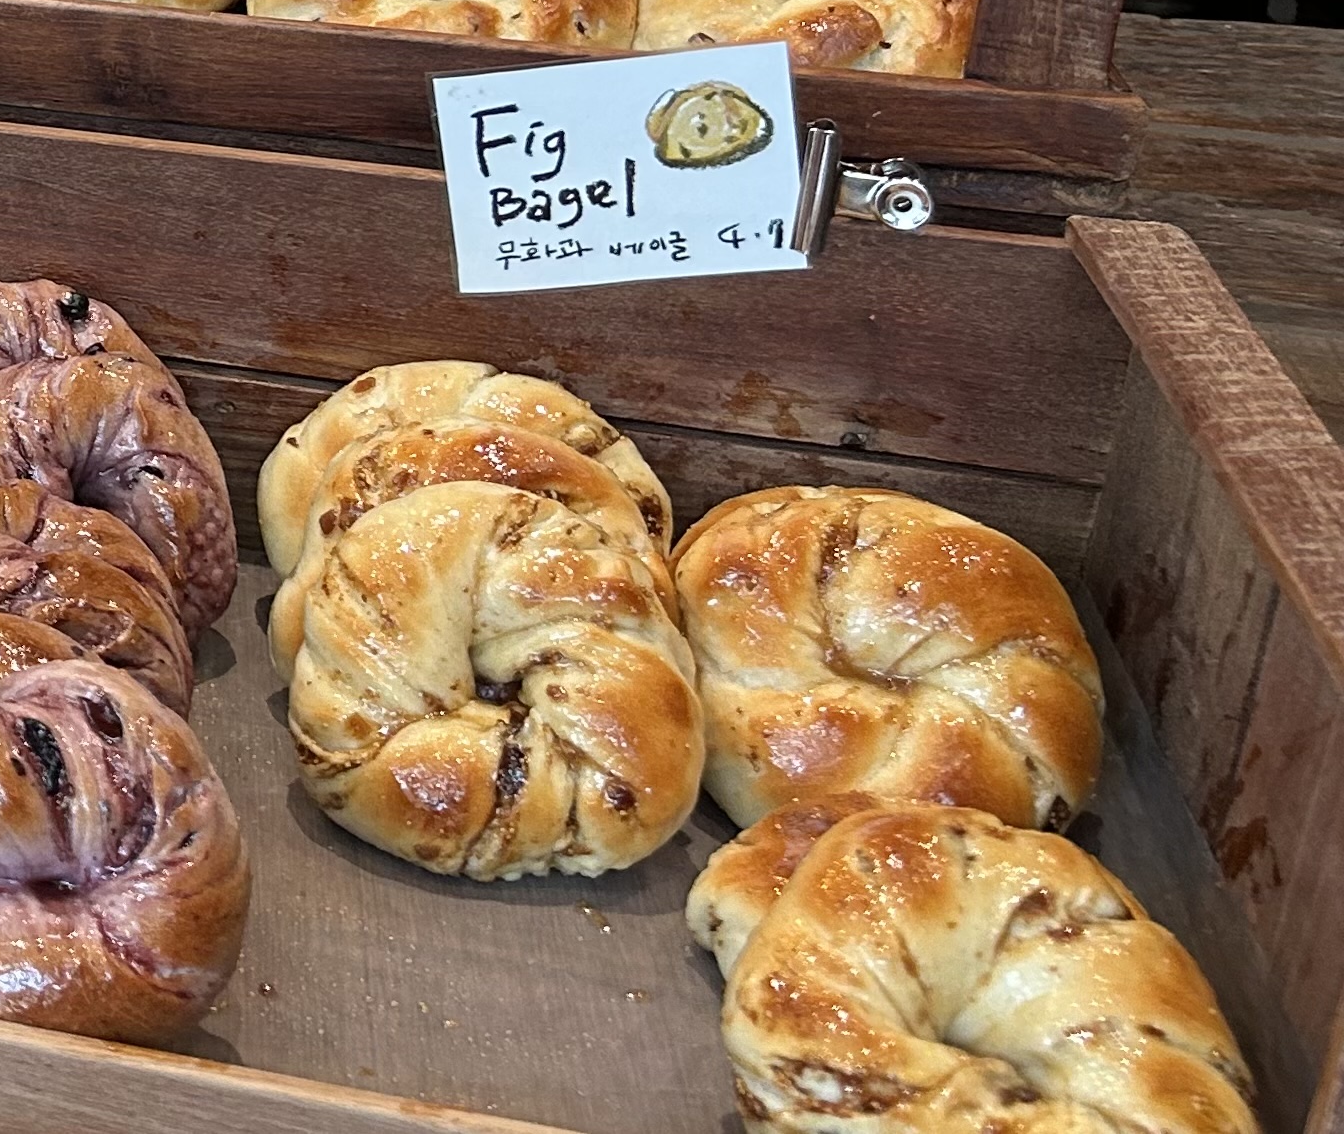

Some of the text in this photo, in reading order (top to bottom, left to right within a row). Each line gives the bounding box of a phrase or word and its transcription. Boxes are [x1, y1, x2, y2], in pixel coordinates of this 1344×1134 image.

[470, 104, 566, 182] Fig
[489, 157, 636, 229] Bagel
[495, 236, 593, 270] 무화과
[609, 230, 691, 262] 베이글
